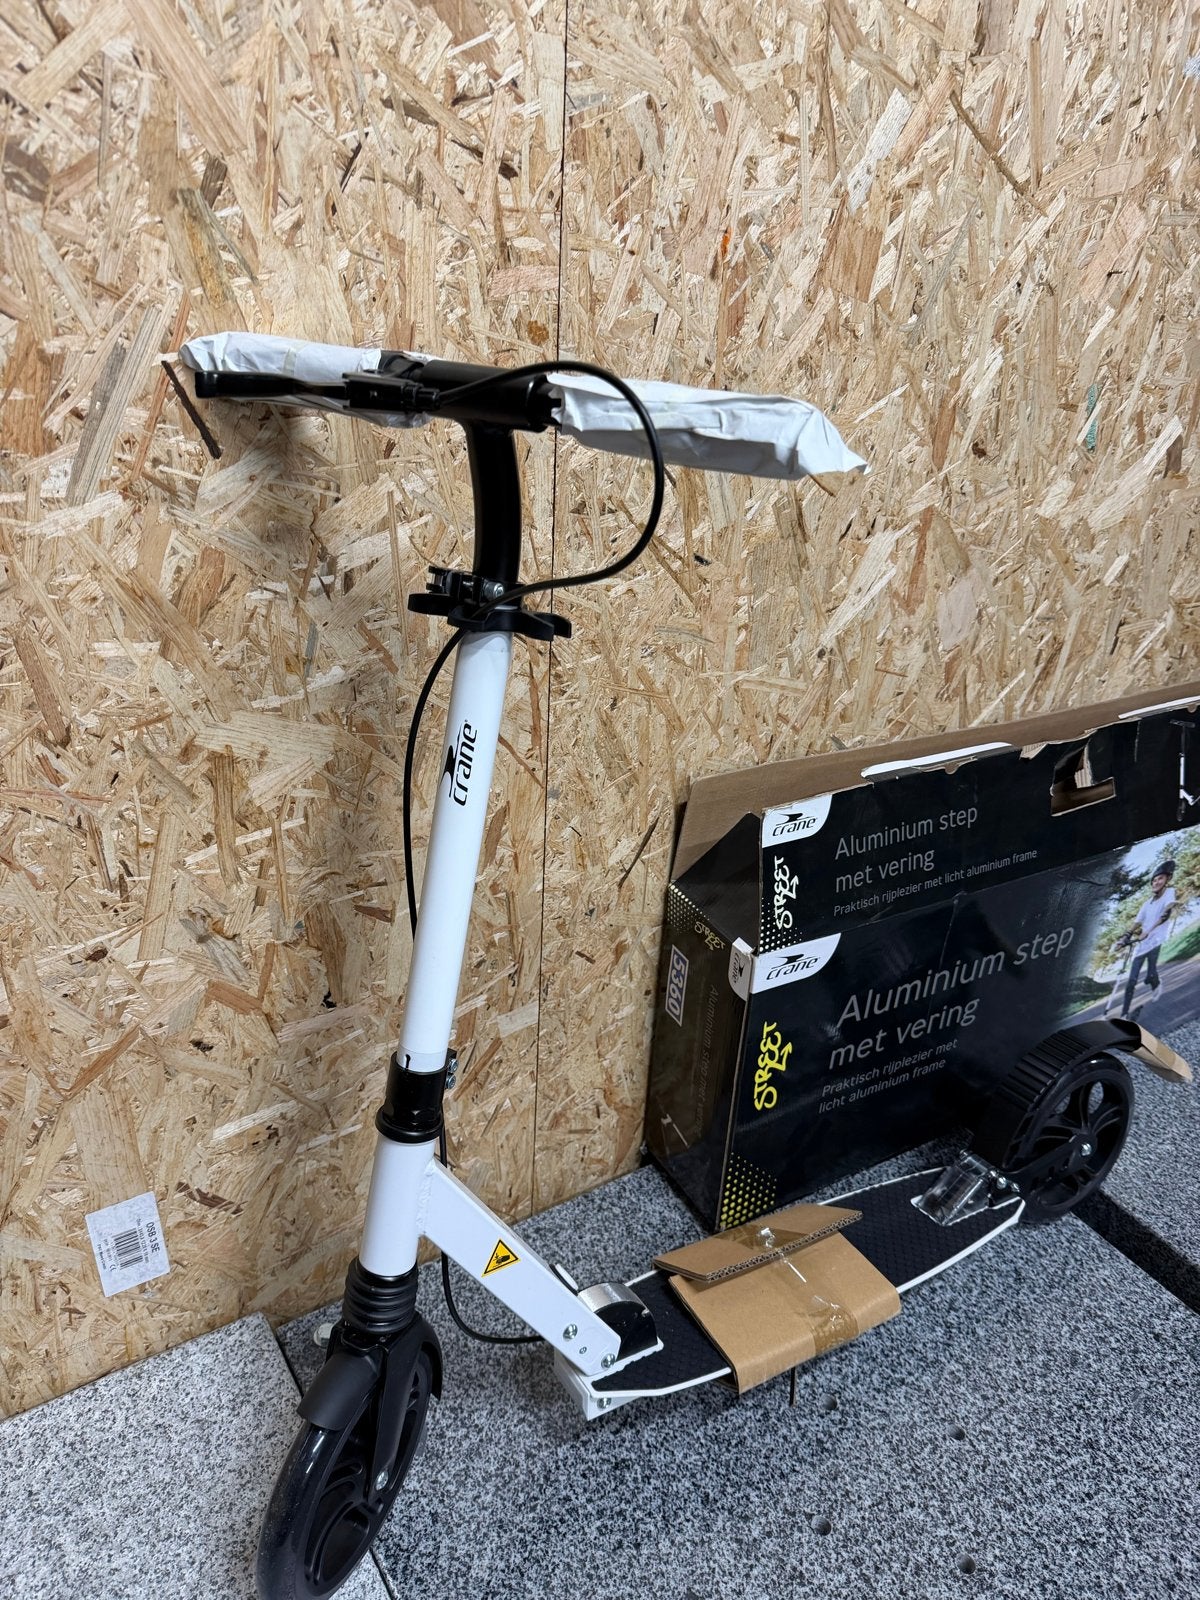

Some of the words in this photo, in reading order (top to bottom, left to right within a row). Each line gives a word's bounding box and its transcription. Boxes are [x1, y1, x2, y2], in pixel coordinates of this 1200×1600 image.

[453, 722, 478, 807] crane
[772, 817, 817, 837] crane
[835, 818, 933, 860] Aluminium
[939, 807, 978, 831] step
[773, 855, 798, 930] STREET
[833, 895, 880, 917] Praktisch
[882, 882, 922, 903] rijplezier
[925, 876, 942, 890] met
[945, 869, 965, 883] licht
[966, 856, 1011, 877] aluminium
[1012, 850, 1038, 863] frame
[836, 865, 872, 893] met
[879, 850, 935, 879] vering
[695, 921, 726, 950] STREET
[668, 954, 685, 1016] 5360
[766, 957, 819, 981] crane
[836, 951, 1005, 1028] Aluminium
[1013, 927, 1074, 965] step
[703, 984, 719, 1048] Aluminium
[829, 1029, 887, 1070] met
[896, 998, 980, 1044] vering
[754, 1021, 792, 1111] STREET
[818, 1095, 845, 1114] licht
[849, 1073, 909, 1102] aluminium
[912, 1059, 946, 1079] frame
[821, 1066, 879, 1098] Praktisch
[883, 1049, 933, 1076] rijplezier
[936, 1038, 958, 1054] met
[146, 1221, 156, 1237] OSB
[151, 1243, 160, 1253] SE
